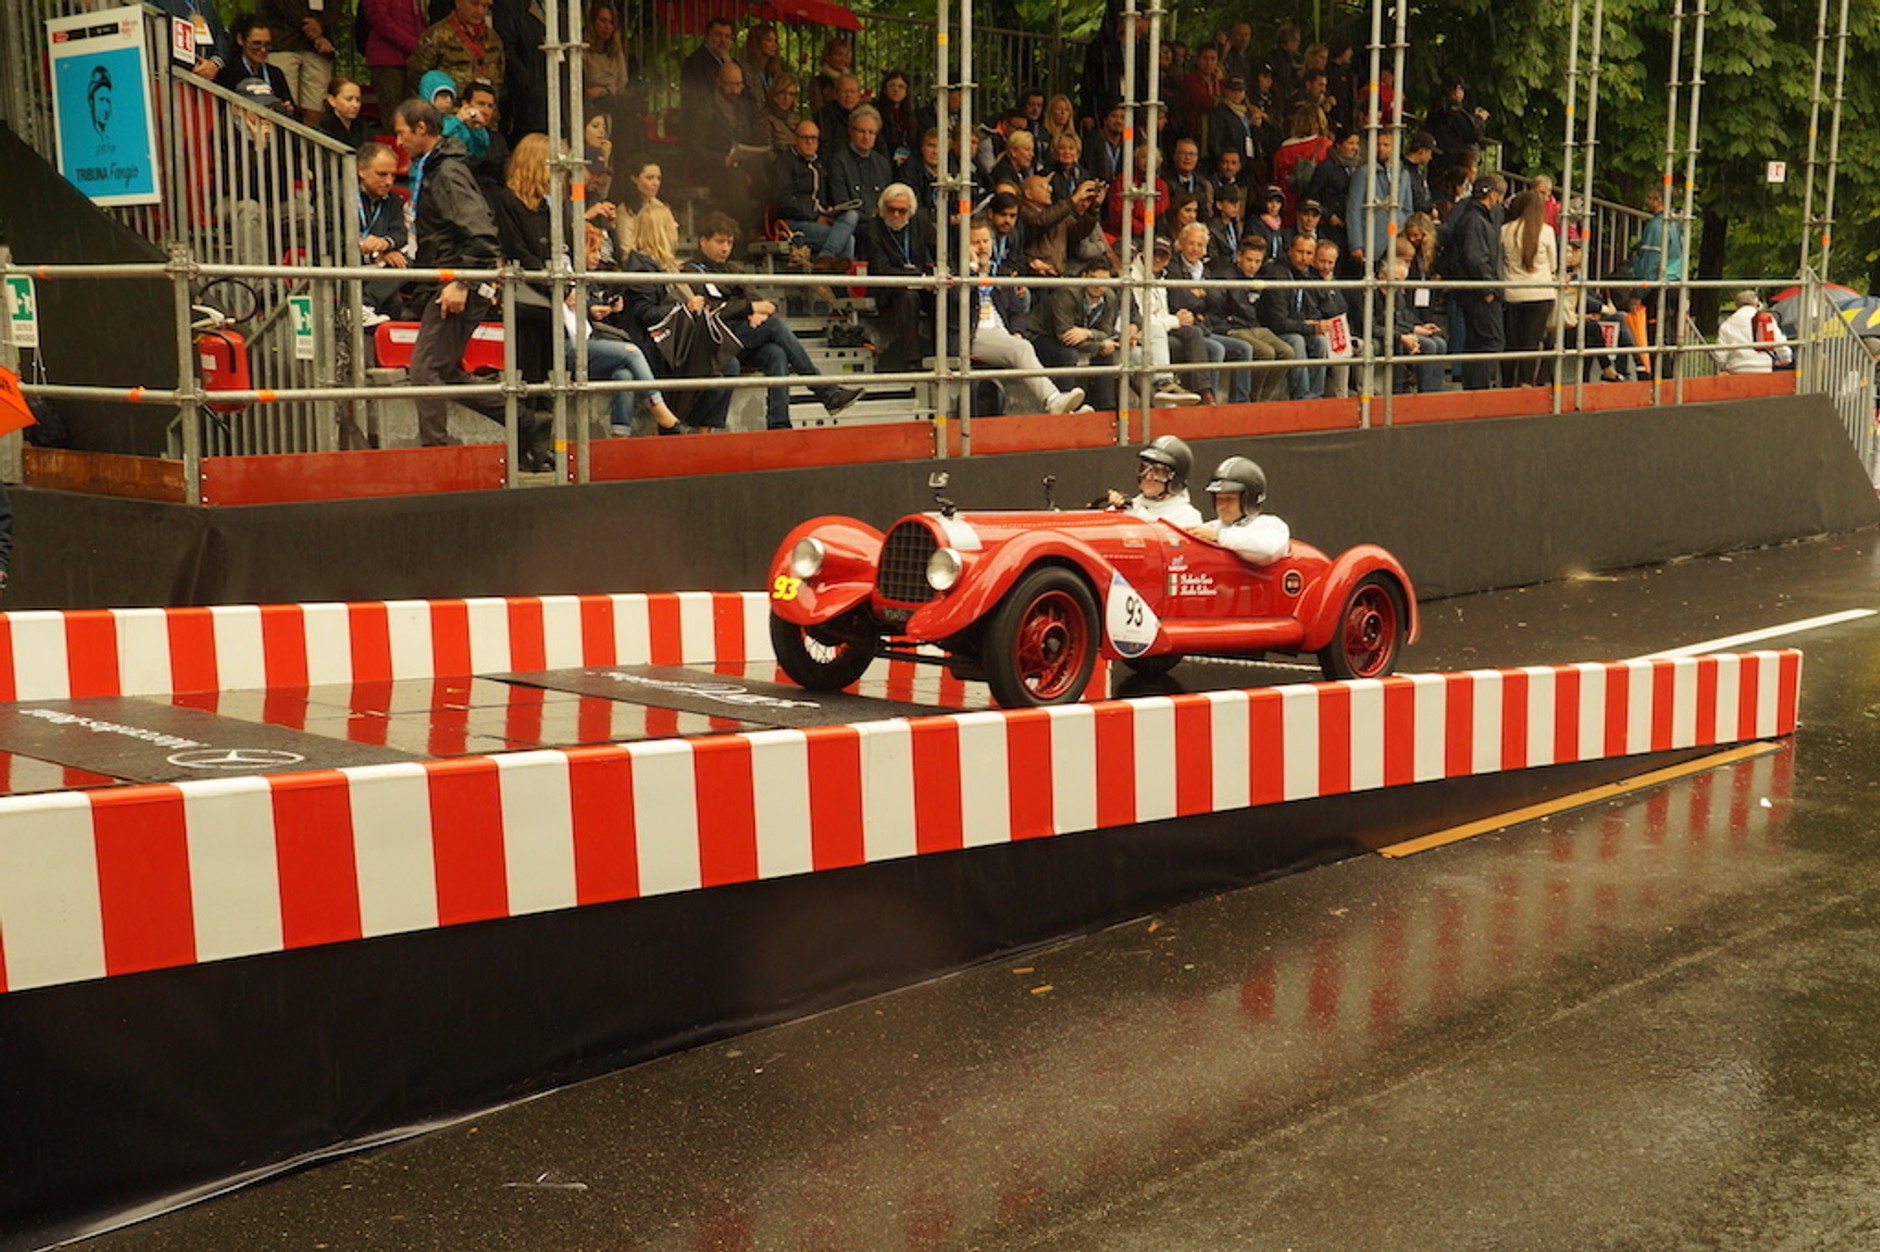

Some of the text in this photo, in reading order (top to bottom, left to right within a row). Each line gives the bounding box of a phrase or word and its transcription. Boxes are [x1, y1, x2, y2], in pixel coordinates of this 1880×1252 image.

[76, 162, 139, 188] TRIBUNA Fangio
[773, 576, 801, 600] 93
[1125, 596, 1143, 628] 93
